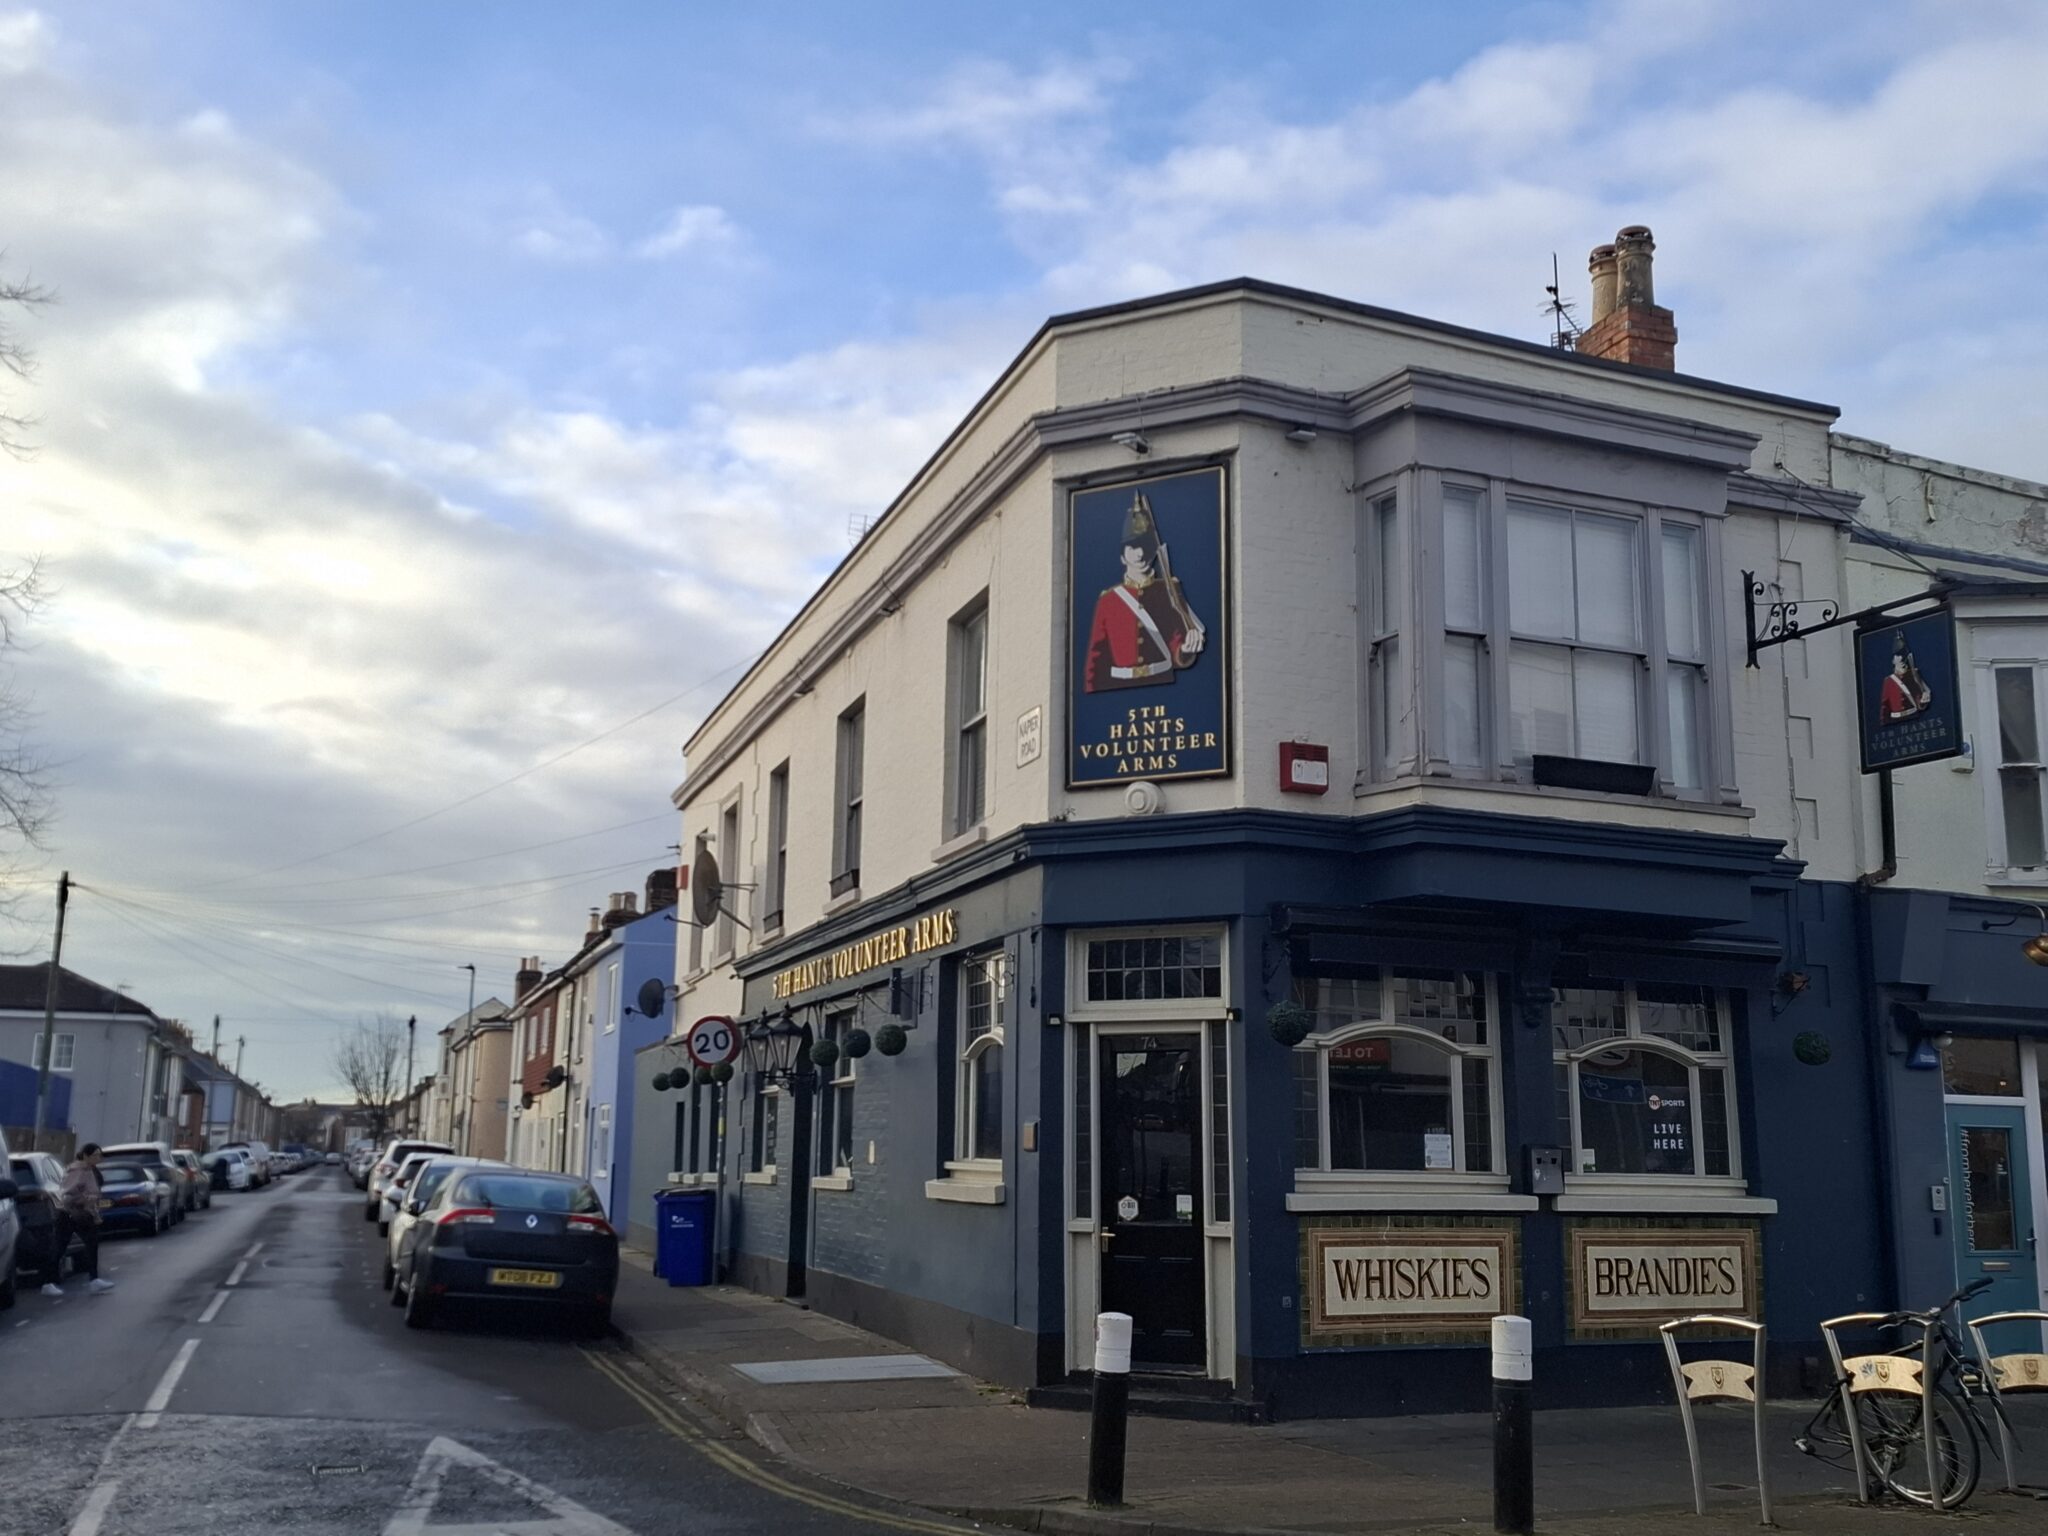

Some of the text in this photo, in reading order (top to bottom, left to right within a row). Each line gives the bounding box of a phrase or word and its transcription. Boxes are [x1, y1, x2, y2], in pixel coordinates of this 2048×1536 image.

[1128, 705, 1166, 721] 5TH
[1110, 718, 1185, 739] HANTS
[1901, 717, 1943, 734] HANTS
[1081, 733, 1216, 759] VOLUNTEER
[1871, 728, 1946, 752] VOLUNTEER
[1893, 743, 1926, 758] ARMS
[1117, 754, 1178, 773] ARMS
[793, 957, 829, 994] HANTS
[831, 927, 907, 980] VOLUNTEER
[912, 908, 955, 953] ARMS
[695, 1030, 730, 1054] 20
[1661, 1099, 1685, 1107] SPORTS
[1653, 1123, 1682, 1134] LIVE
[1653, 1138, 1684, 1150] HERE
[1960, 1129, 1976, 1253] #fromhereforhere
[1332, 1258, 1491, 1301] WHISKIES
[1594, 1257, 1736, 1297] BRANDIES
